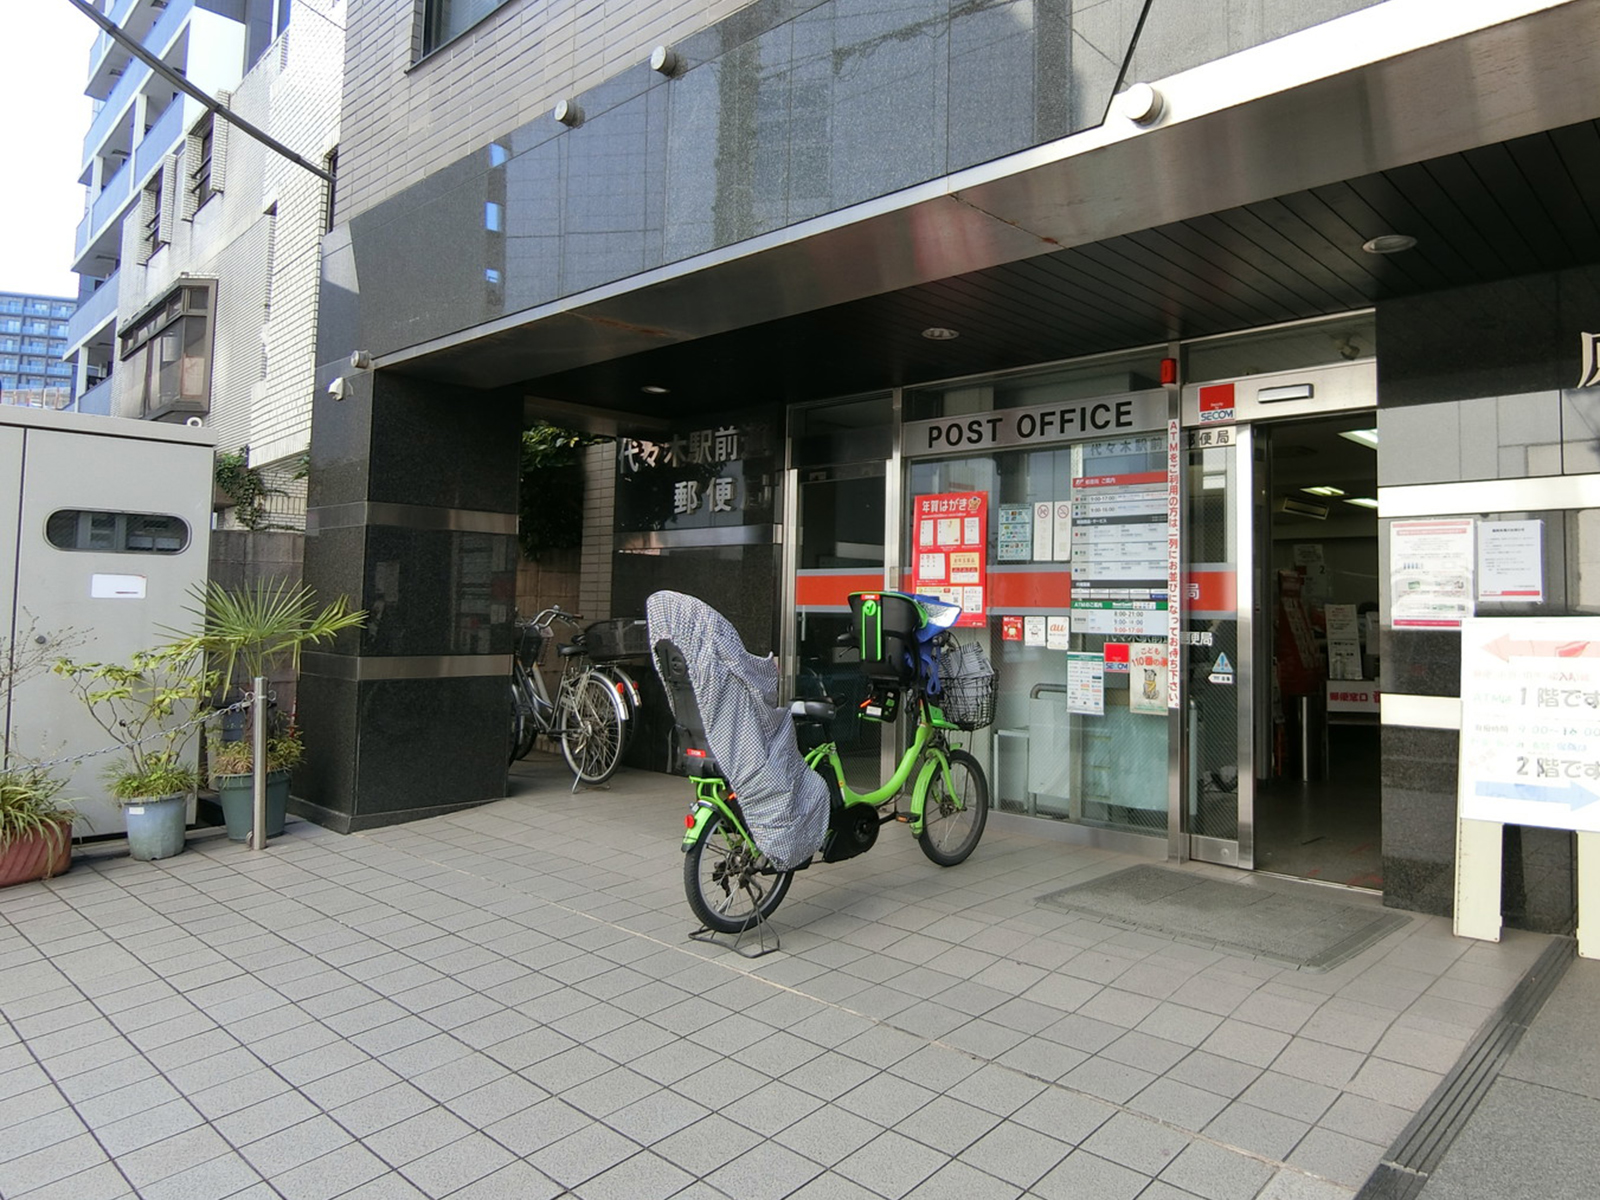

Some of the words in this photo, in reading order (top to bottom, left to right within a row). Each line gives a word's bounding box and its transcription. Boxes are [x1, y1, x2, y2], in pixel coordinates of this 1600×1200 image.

[1201, 410, 1233, 422] SECOM
[928, 418, 1003, 449] POST
[1016, 401, 1133, 438] OFFICE
[922, 498, 967, 512] 年賀はがき
[1050, 623, 1066, 632] au
[1141, 647, 1161, 656] こども
